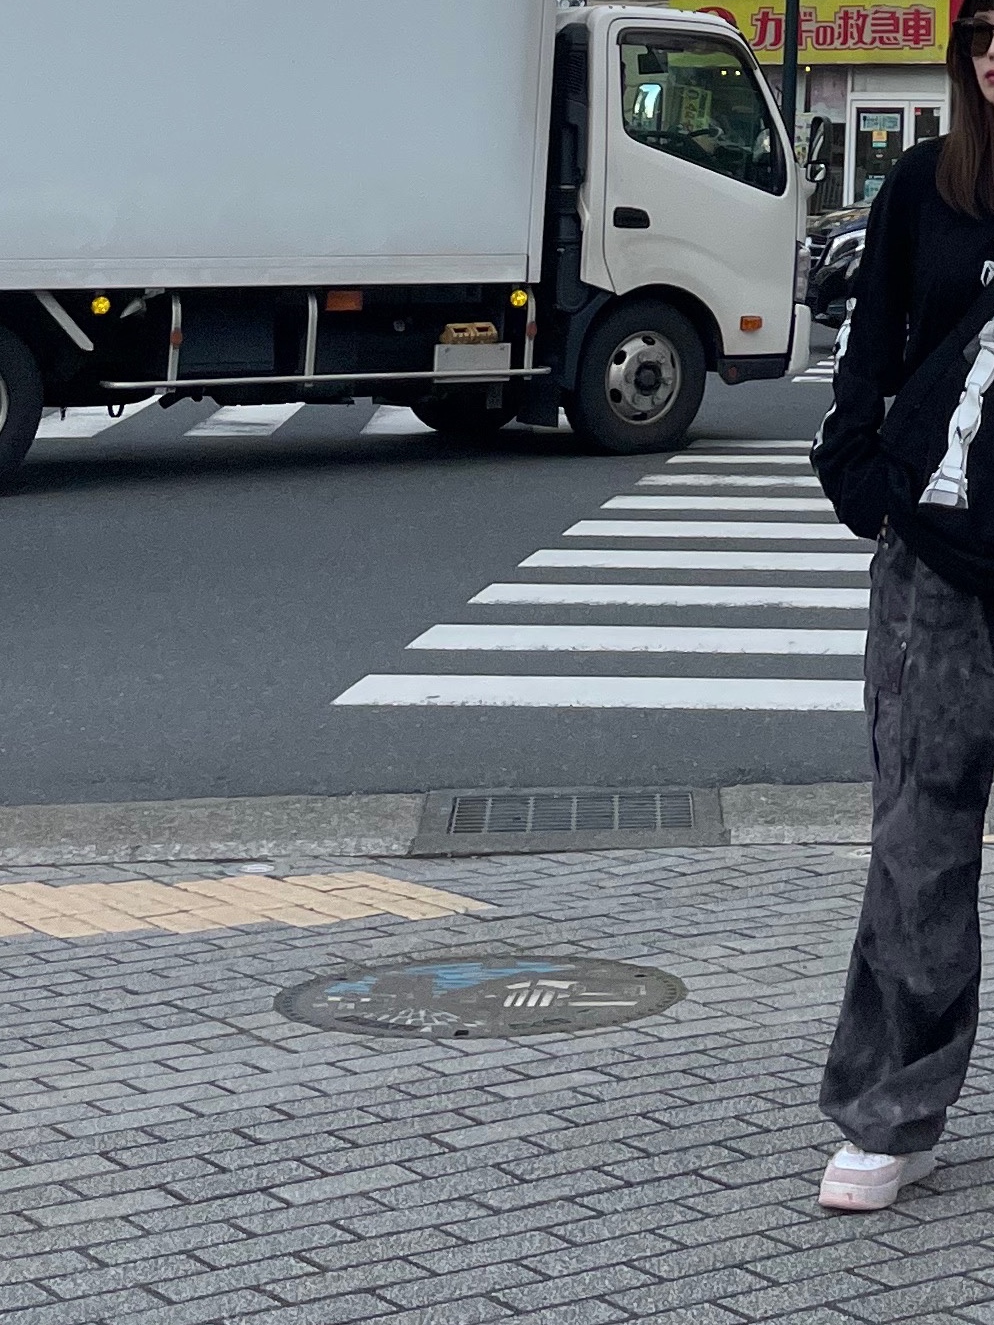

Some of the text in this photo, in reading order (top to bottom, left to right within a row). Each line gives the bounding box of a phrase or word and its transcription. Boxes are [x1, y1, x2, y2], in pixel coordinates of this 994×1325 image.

[750, 4, 936, 51] カギの救急車
